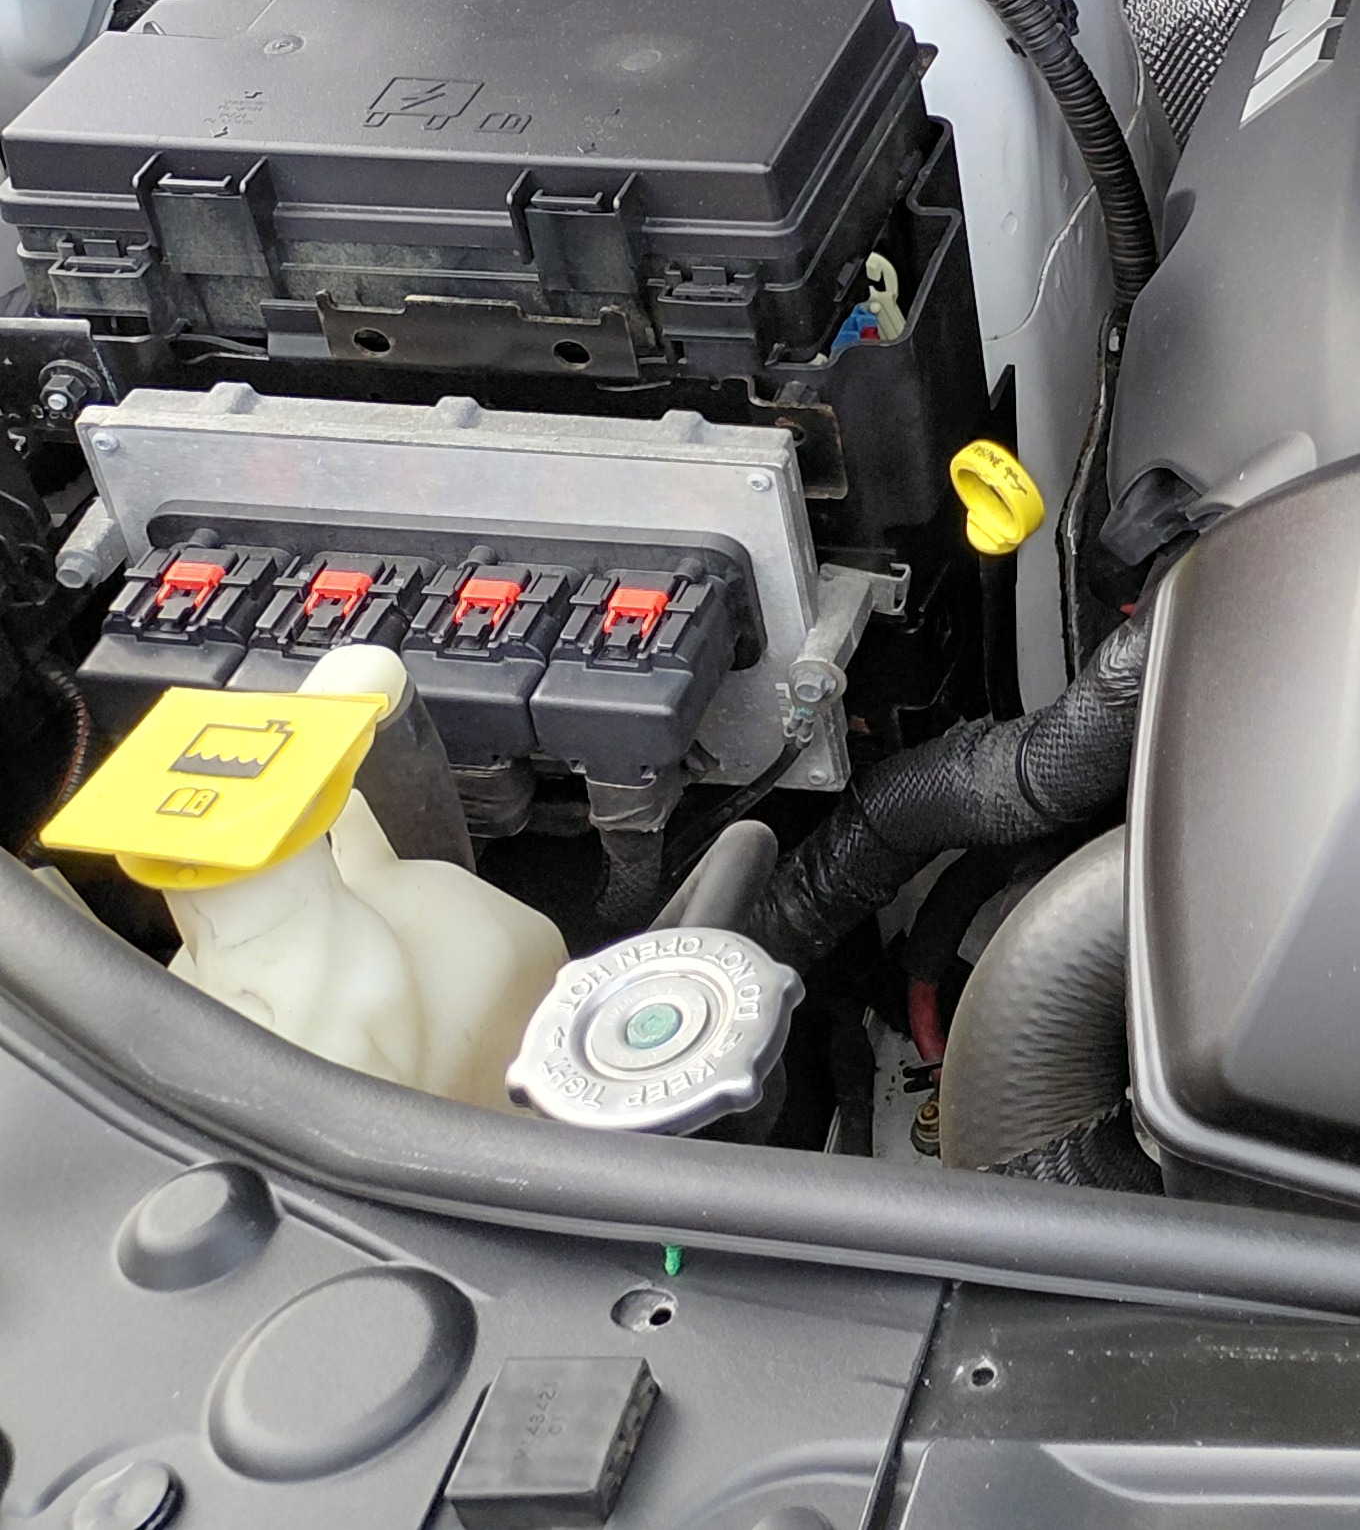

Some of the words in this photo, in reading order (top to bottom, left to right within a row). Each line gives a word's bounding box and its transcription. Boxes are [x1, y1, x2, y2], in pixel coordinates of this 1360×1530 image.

[614, 937, 703, 972] OPEN
[703, 943, 756, 987] NOT
[557, 963, 613, 1017] HOT
[733, 981, 762, 1022] DO
[539, 1057, 606, 1110] TIGHT
[624, 1057, 718, 1108] KEEP
